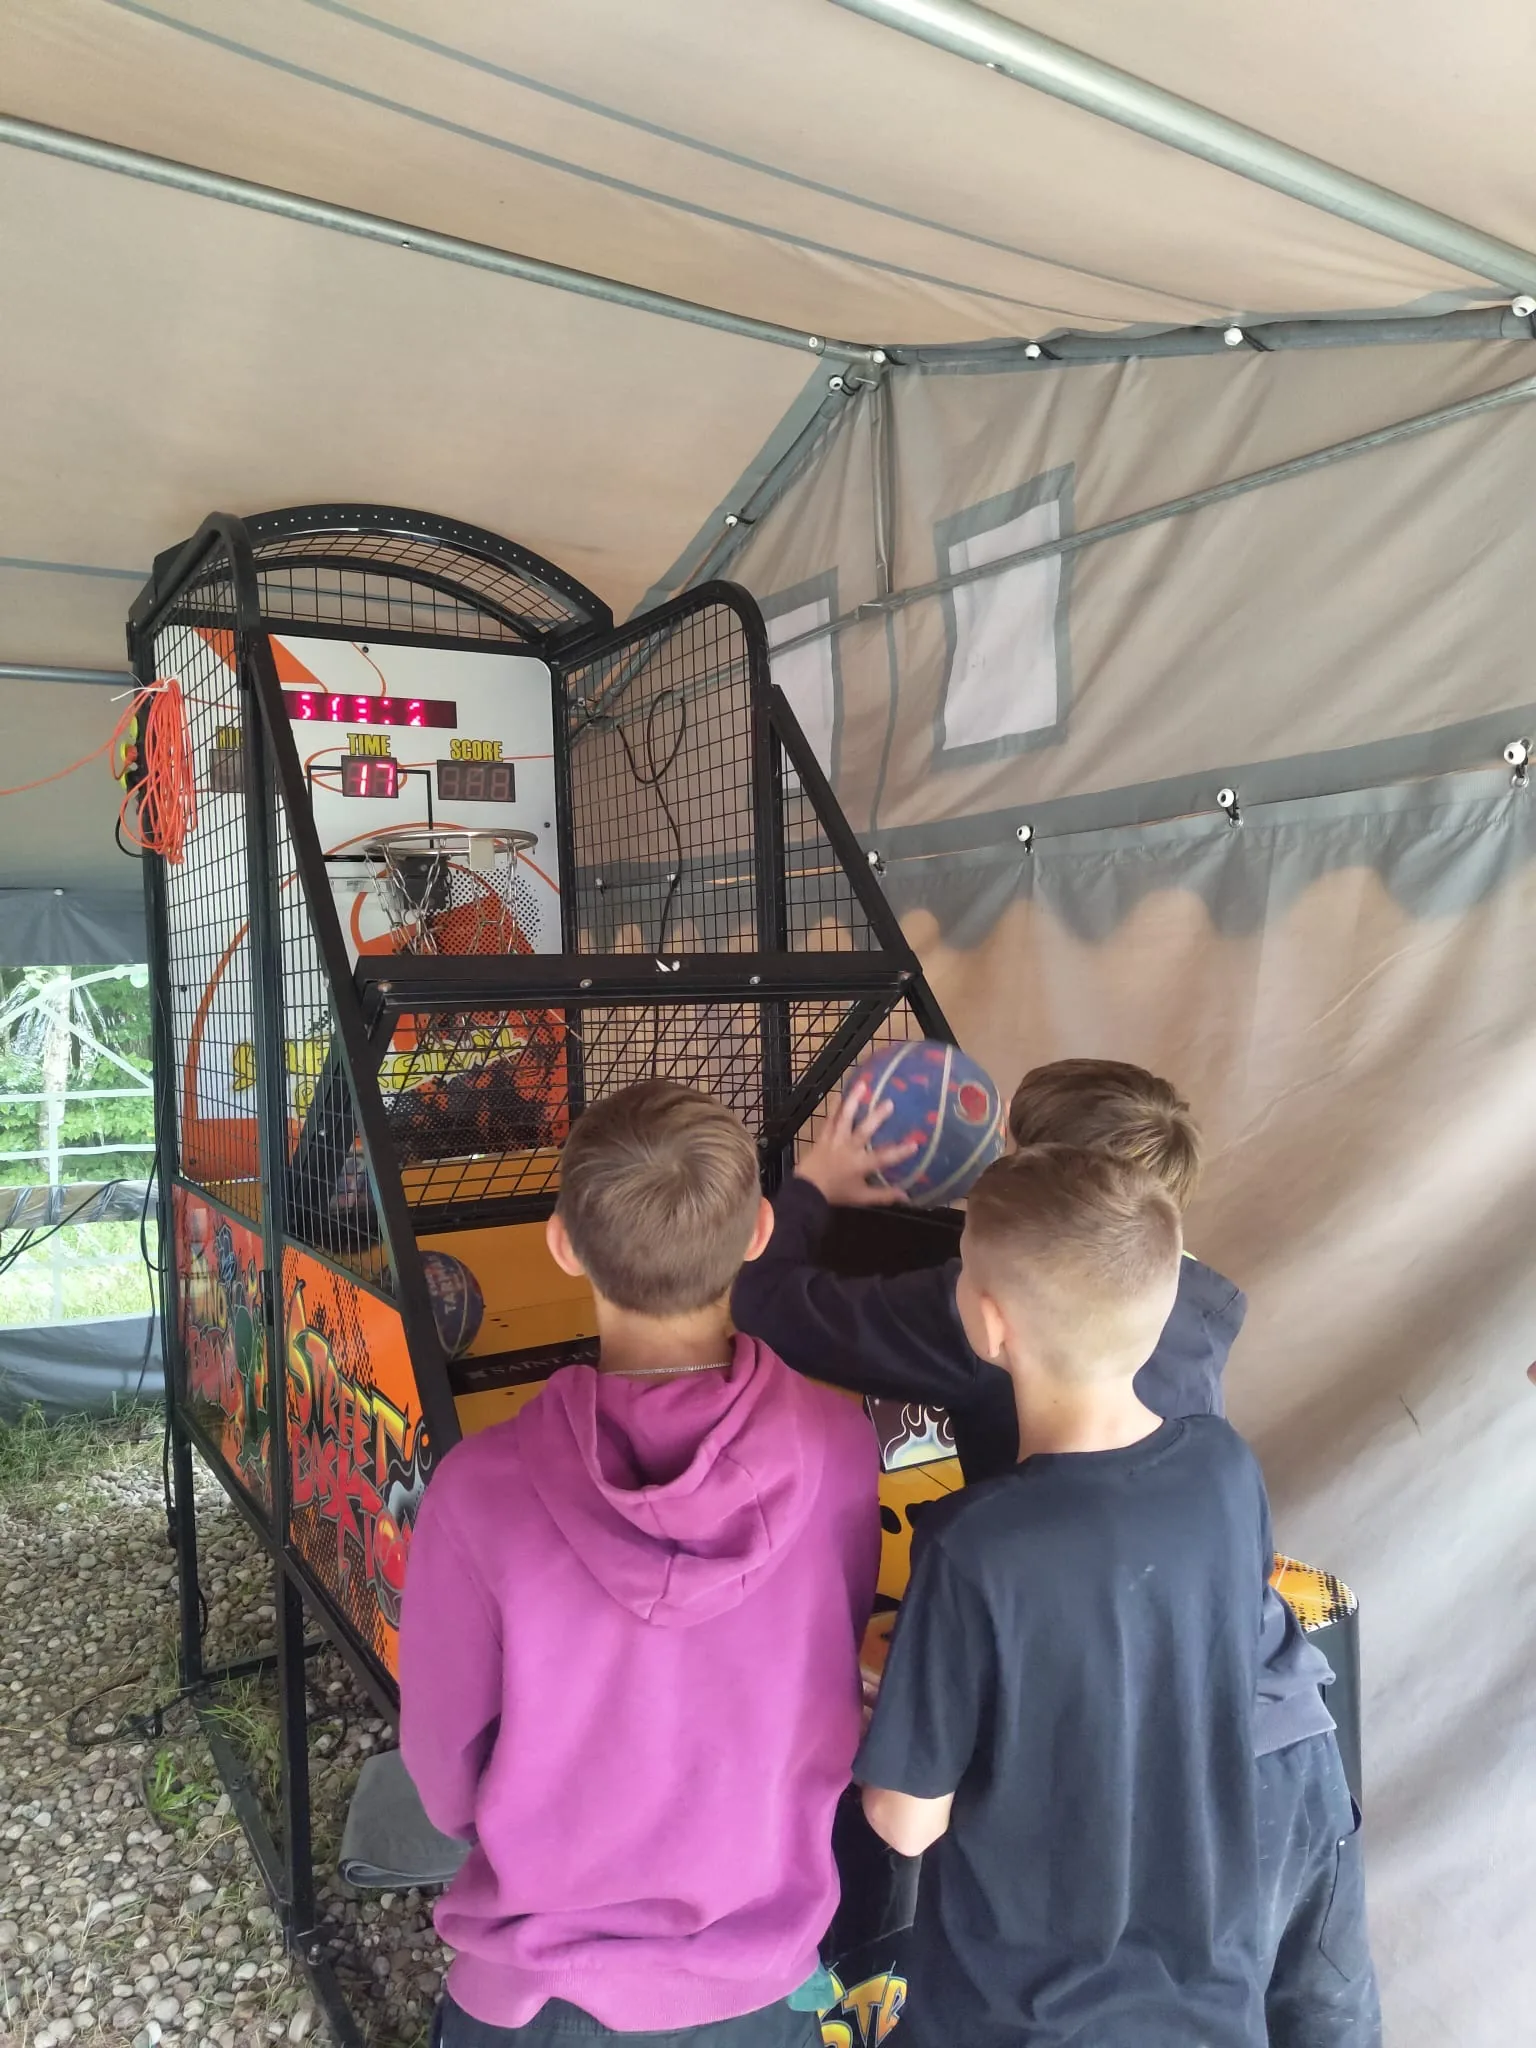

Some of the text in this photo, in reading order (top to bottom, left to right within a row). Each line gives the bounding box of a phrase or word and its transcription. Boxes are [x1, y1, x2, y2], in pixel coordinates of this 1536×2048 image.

[347, 733, 392, 758] TIME
[450, 739, 504, 762] SCORE
[360, 763, 394, 796] 17
[286, 1277, 409, 1488] STREET
